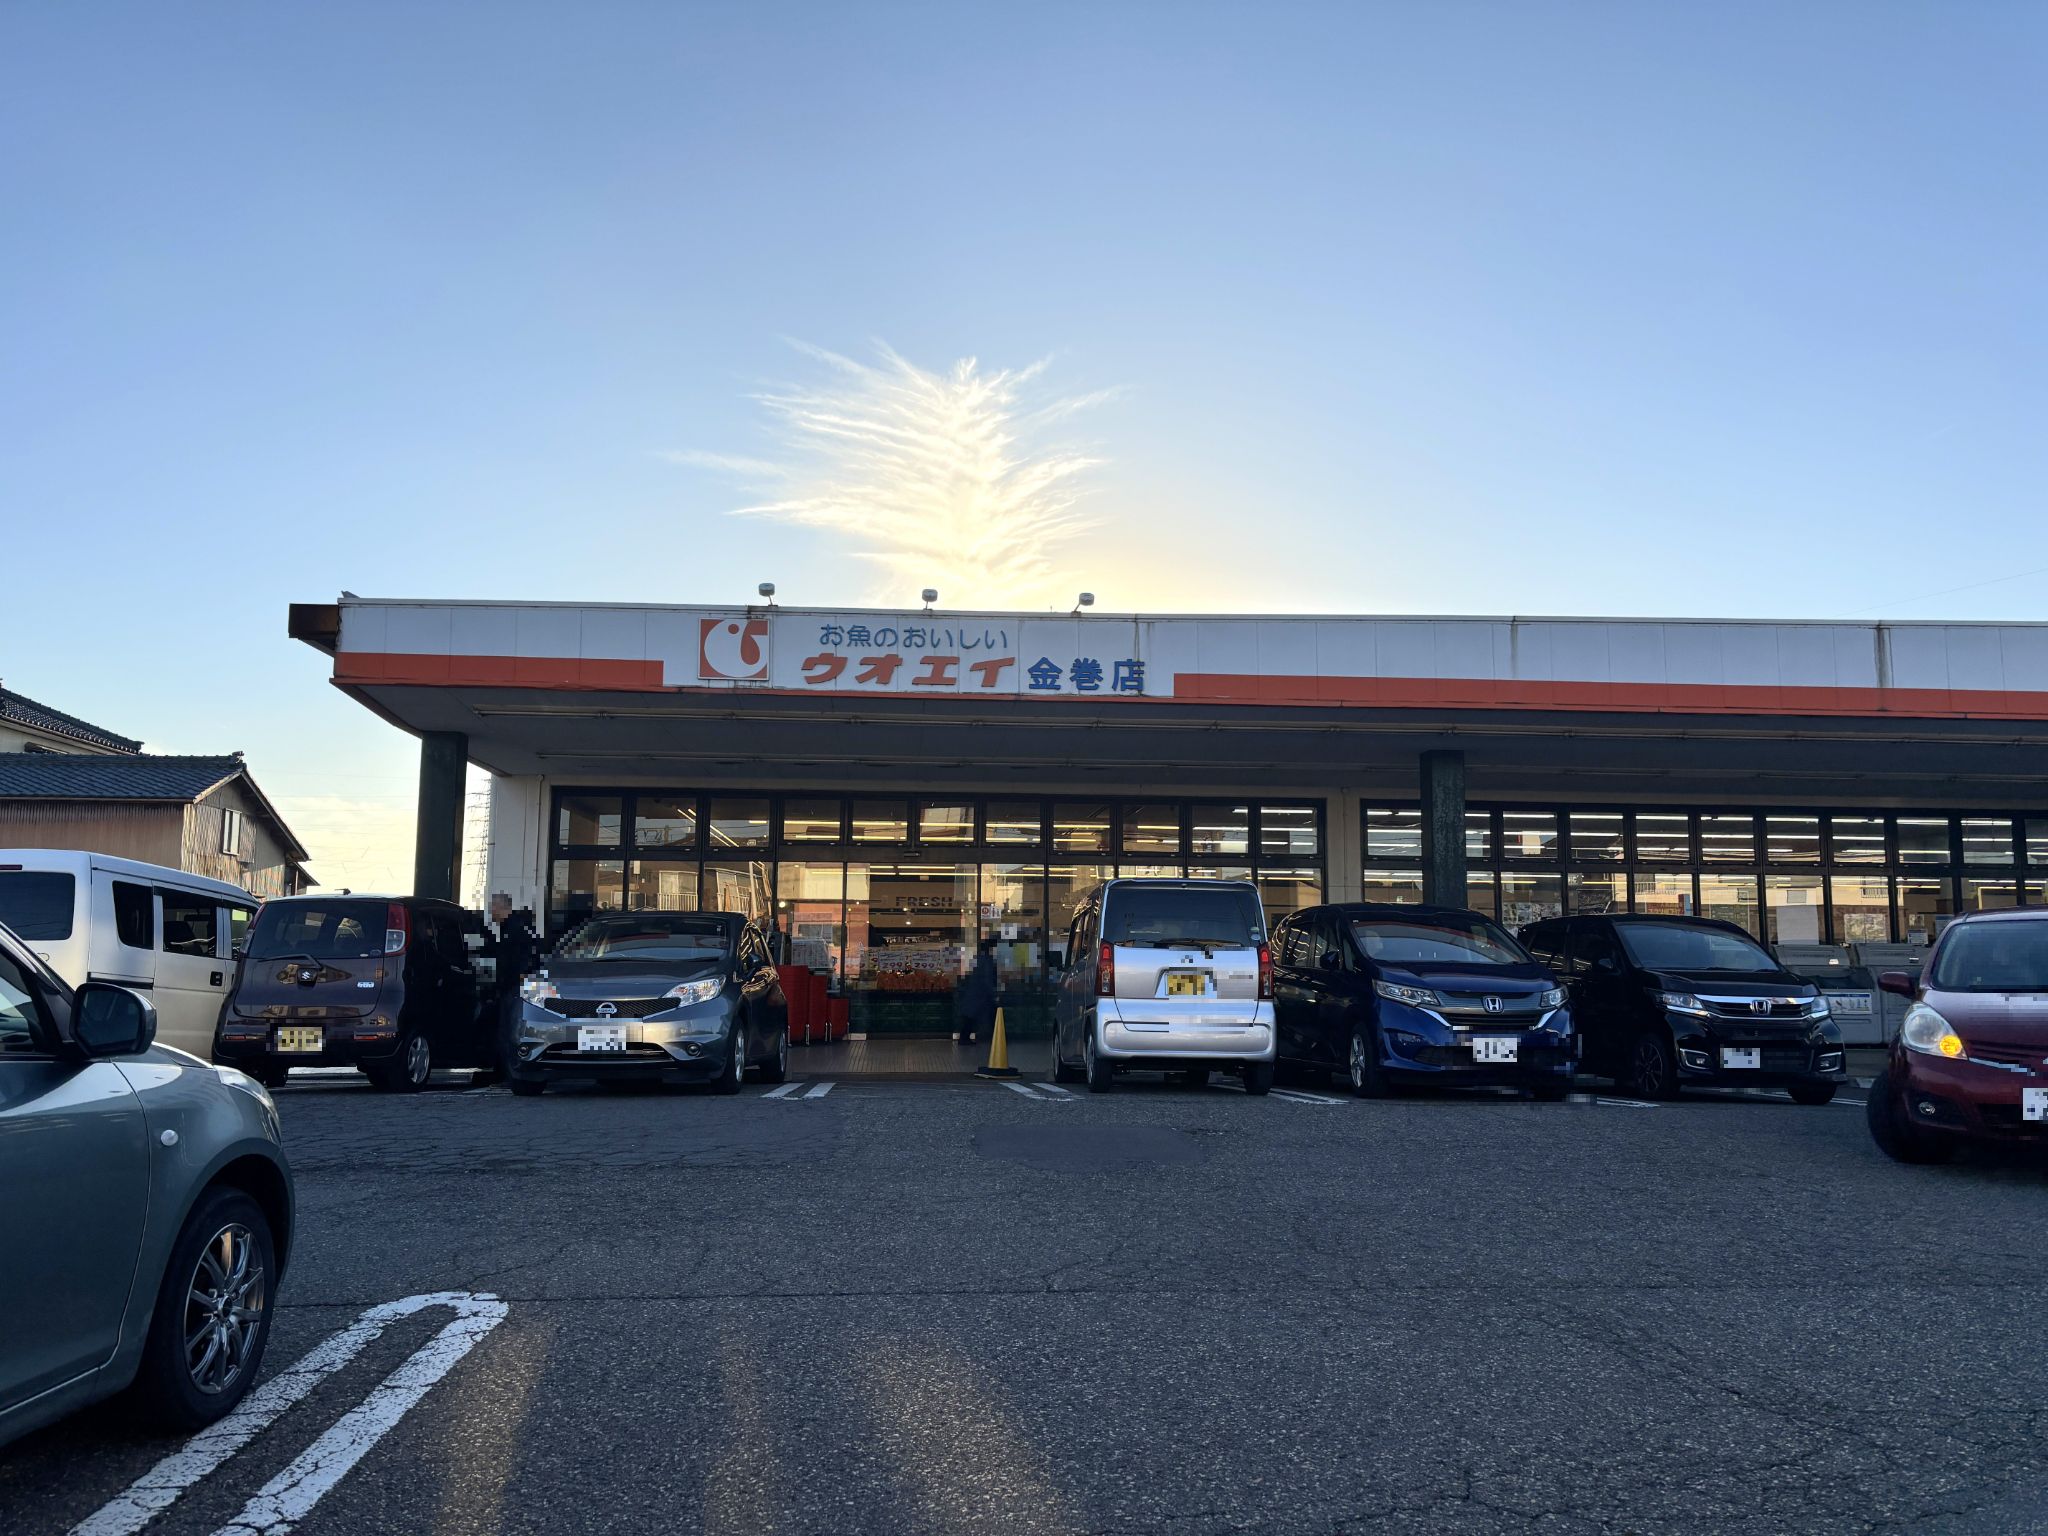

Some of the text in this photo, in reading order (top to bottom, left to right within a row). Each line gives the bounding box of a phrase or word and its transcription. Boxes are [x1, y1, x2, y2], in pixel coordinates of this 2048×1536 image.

[819, 624, 1008, 649] お魚のおいしい
[801, 652, 1145, 691] ウオエイ 金巻店
[895, 896, 953, 907] FRESH
